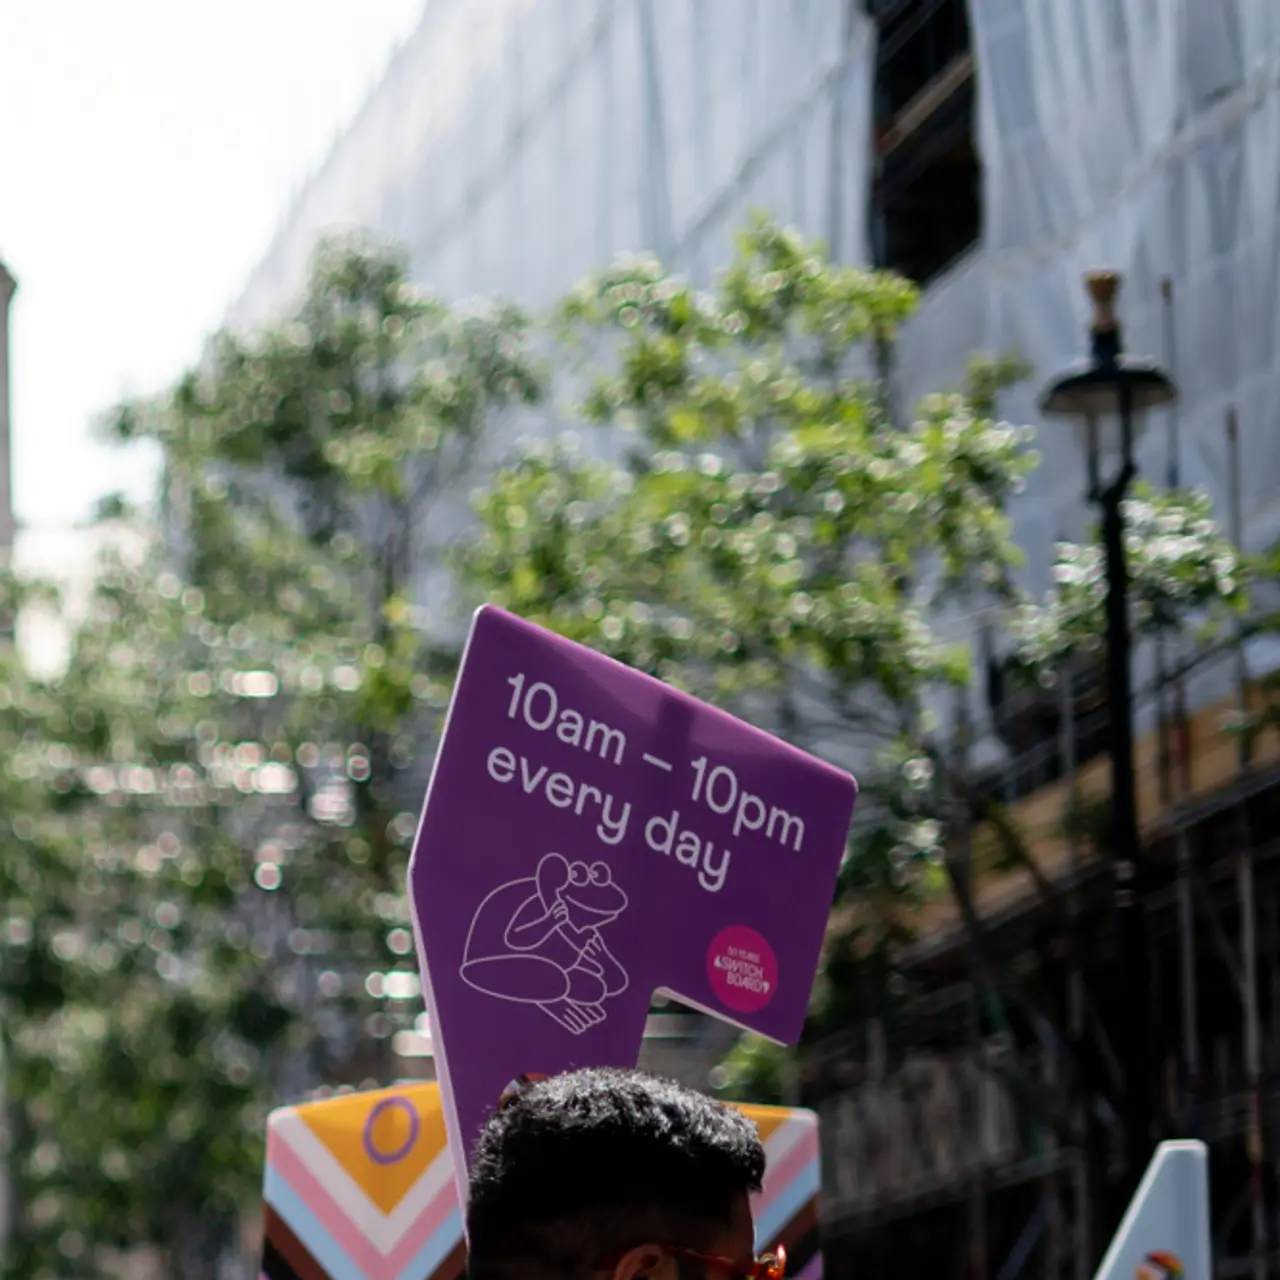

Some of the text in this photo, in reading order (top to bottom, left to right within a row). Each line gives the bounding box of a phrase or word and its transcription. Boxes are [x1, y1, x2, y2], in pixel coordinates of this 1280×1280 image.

[486, 745, 732, 893] every day
[506, 672, 627, 765] 10am
[690, 756, 807, 852] 10pm
